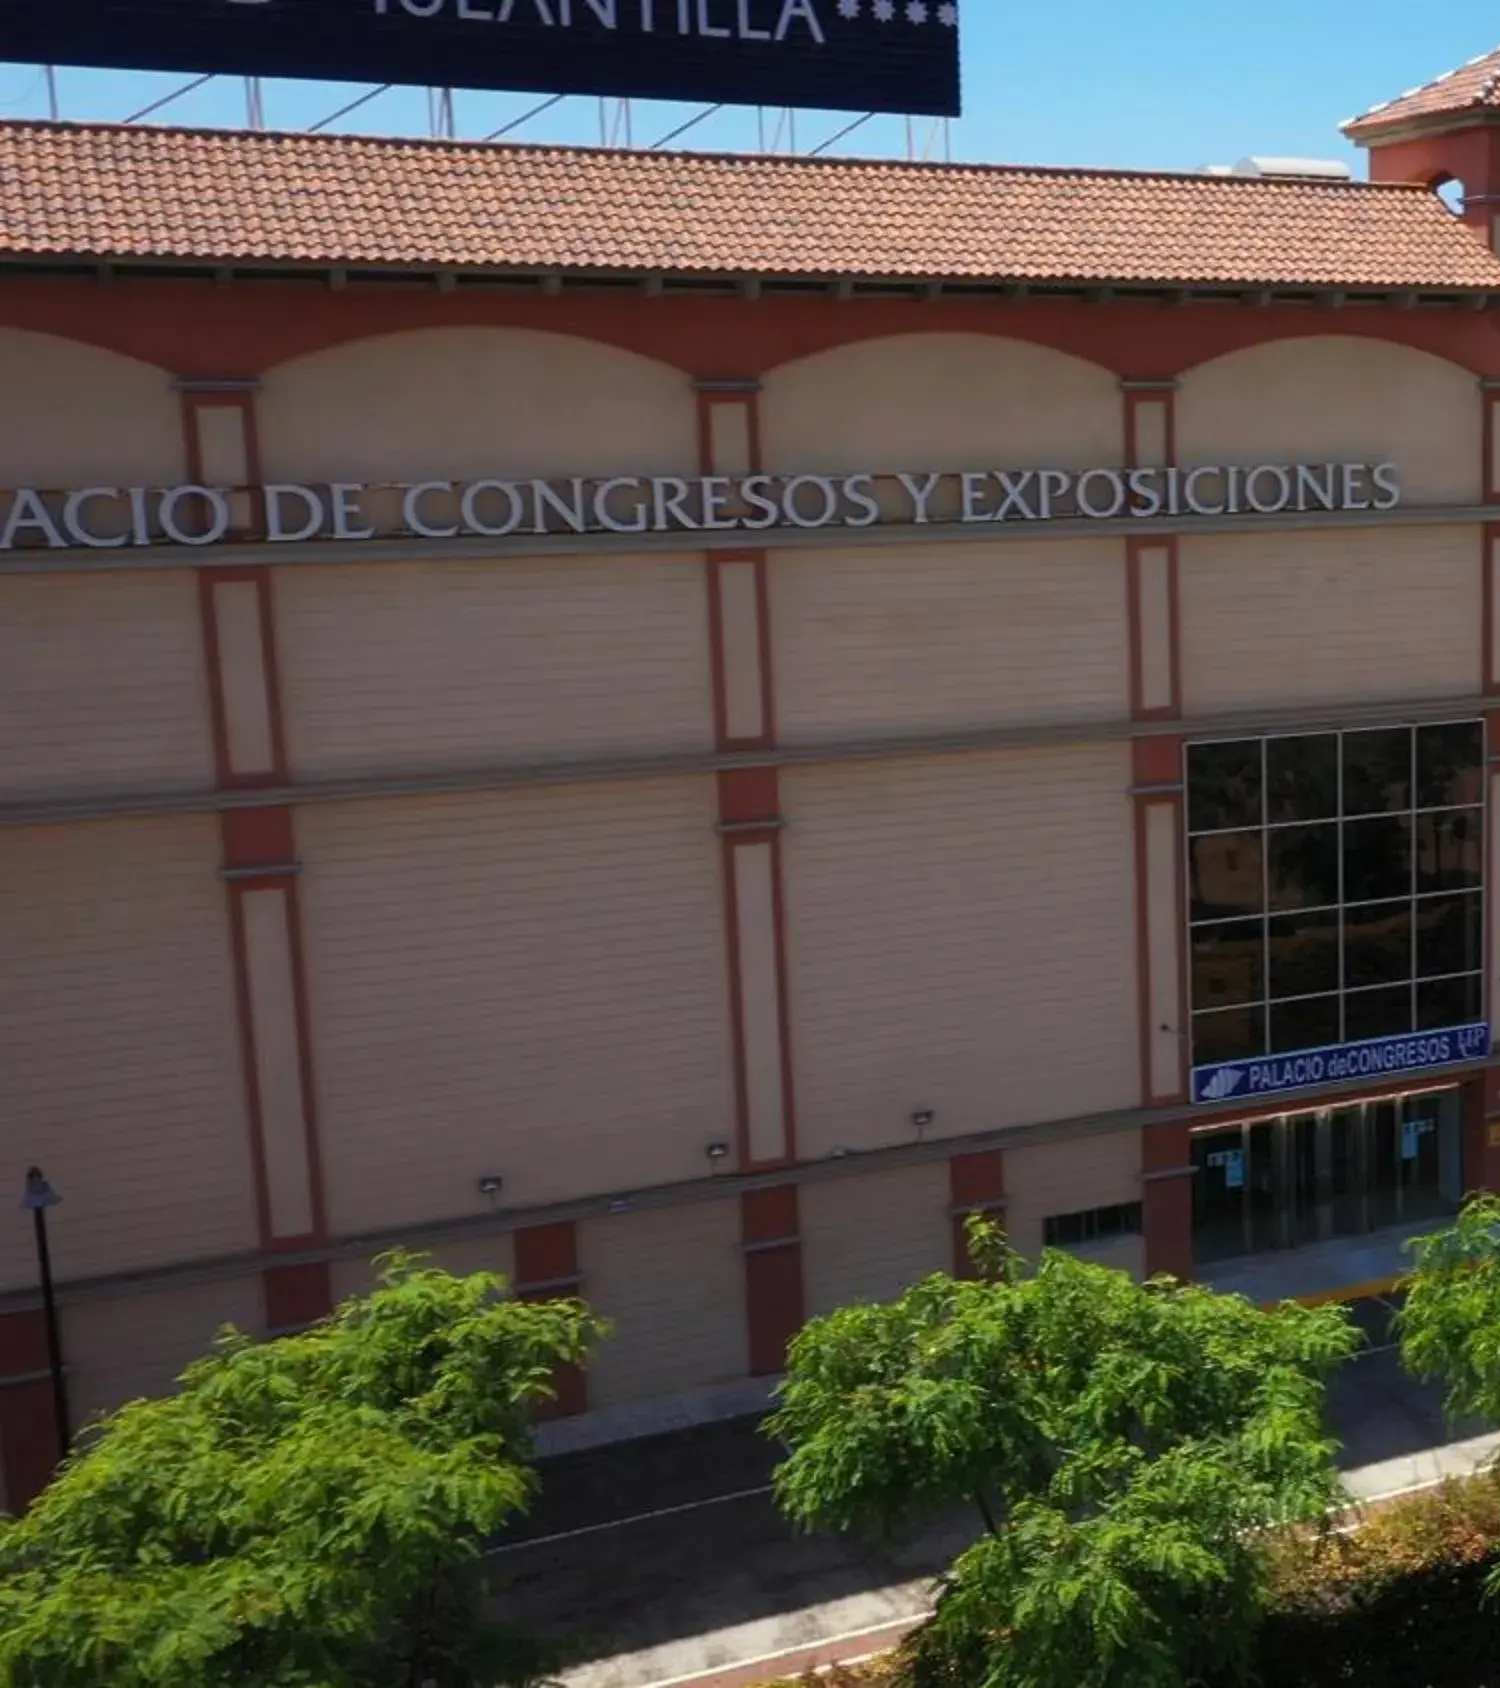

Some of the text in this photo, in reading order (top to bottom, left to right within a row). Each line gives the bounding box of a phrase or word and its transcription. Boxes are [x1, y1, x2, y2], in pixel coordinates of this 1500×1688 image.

[267, 483, 375, 542] DE
[403, 474, 880, 536] CONGRESOS
[899, 473, 941, 523] Y
[961, 463, 1400, 522] EXPOSICIONES
[1249, 1055, 1325, 1090] PALACIO
